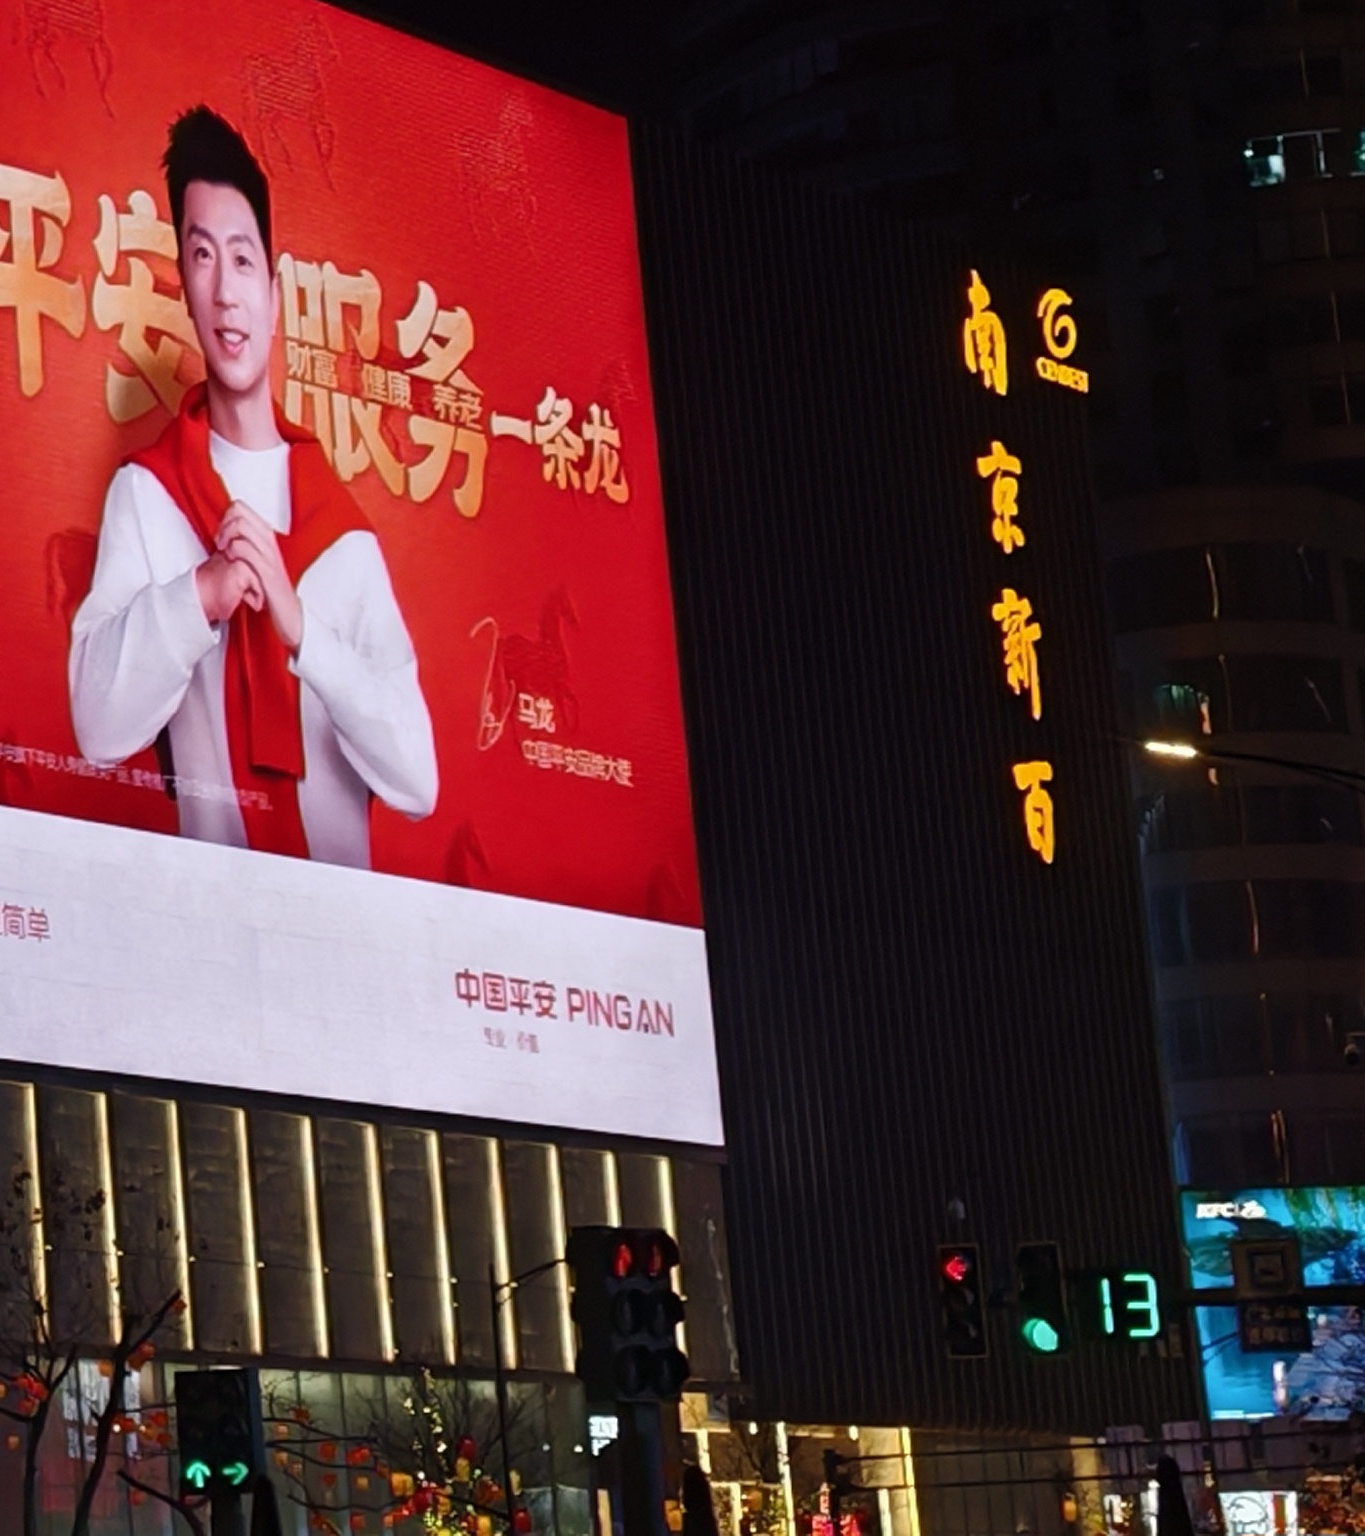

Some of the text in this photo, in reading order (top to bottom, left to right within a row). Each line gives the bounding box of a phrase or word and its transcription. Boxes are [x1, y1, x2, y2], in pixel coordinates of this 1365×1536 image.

[964, 269, 1055, 864] 南京新百
[517, 692, 557, 734] 马龙
[455, 967, 559, 1021] 中国平安
[1100, 1274, 1160, 1338] 13
